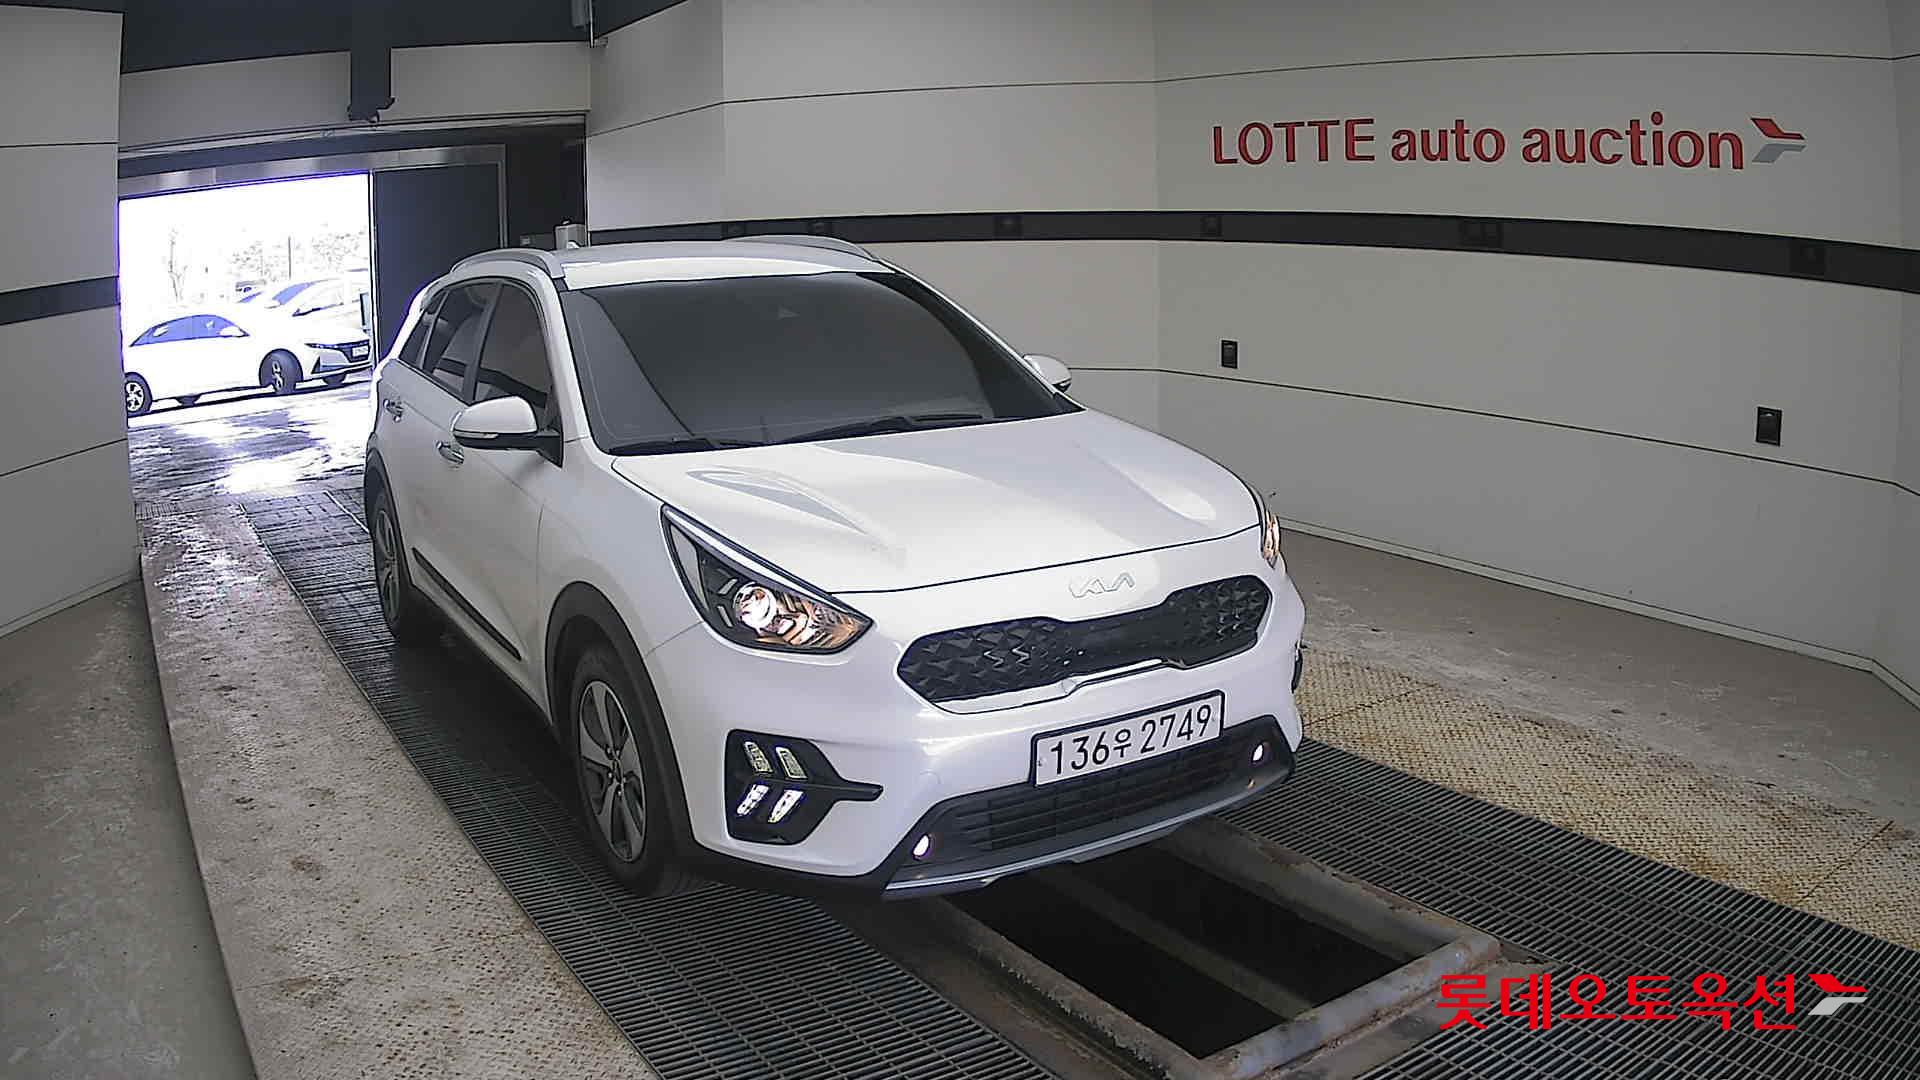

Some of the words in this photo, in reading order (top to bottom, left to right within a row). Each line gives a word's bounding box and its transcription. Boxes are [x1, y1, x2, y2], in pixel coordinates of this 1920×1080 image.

[1212, 118, 1375, 165] LOTTE
[1391, 119, 1504, 163] auto
[1522, 111, 1744, 170] auction
[1050, 728, 1131, 776] 136우
[1140, 704, 1212, 754] 2749
